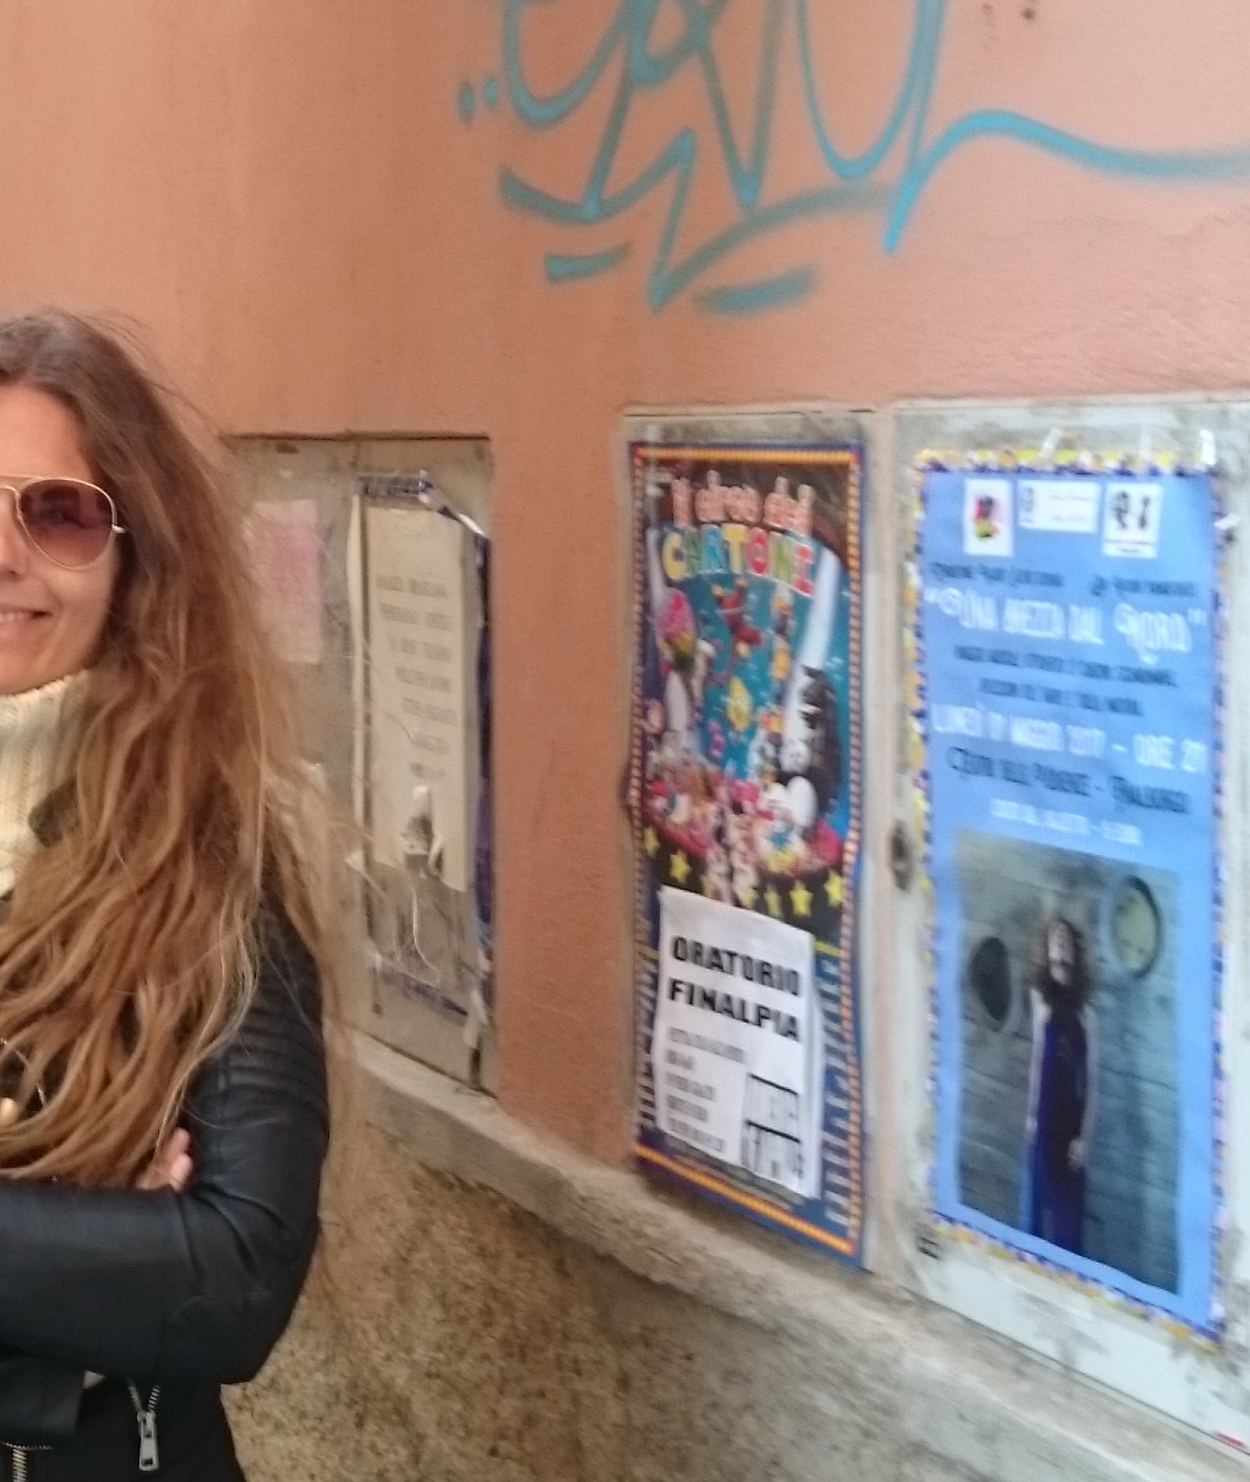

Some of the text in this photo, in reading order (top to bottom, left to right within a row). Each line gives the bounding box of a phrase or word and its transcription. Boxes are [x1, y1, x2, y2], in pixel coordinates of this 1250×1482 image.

[662, 523, 815, 598] CARTONI
[672, 935, 801, 996] ORATORIO
[668, 976, 801, 1043] FINALPIA
